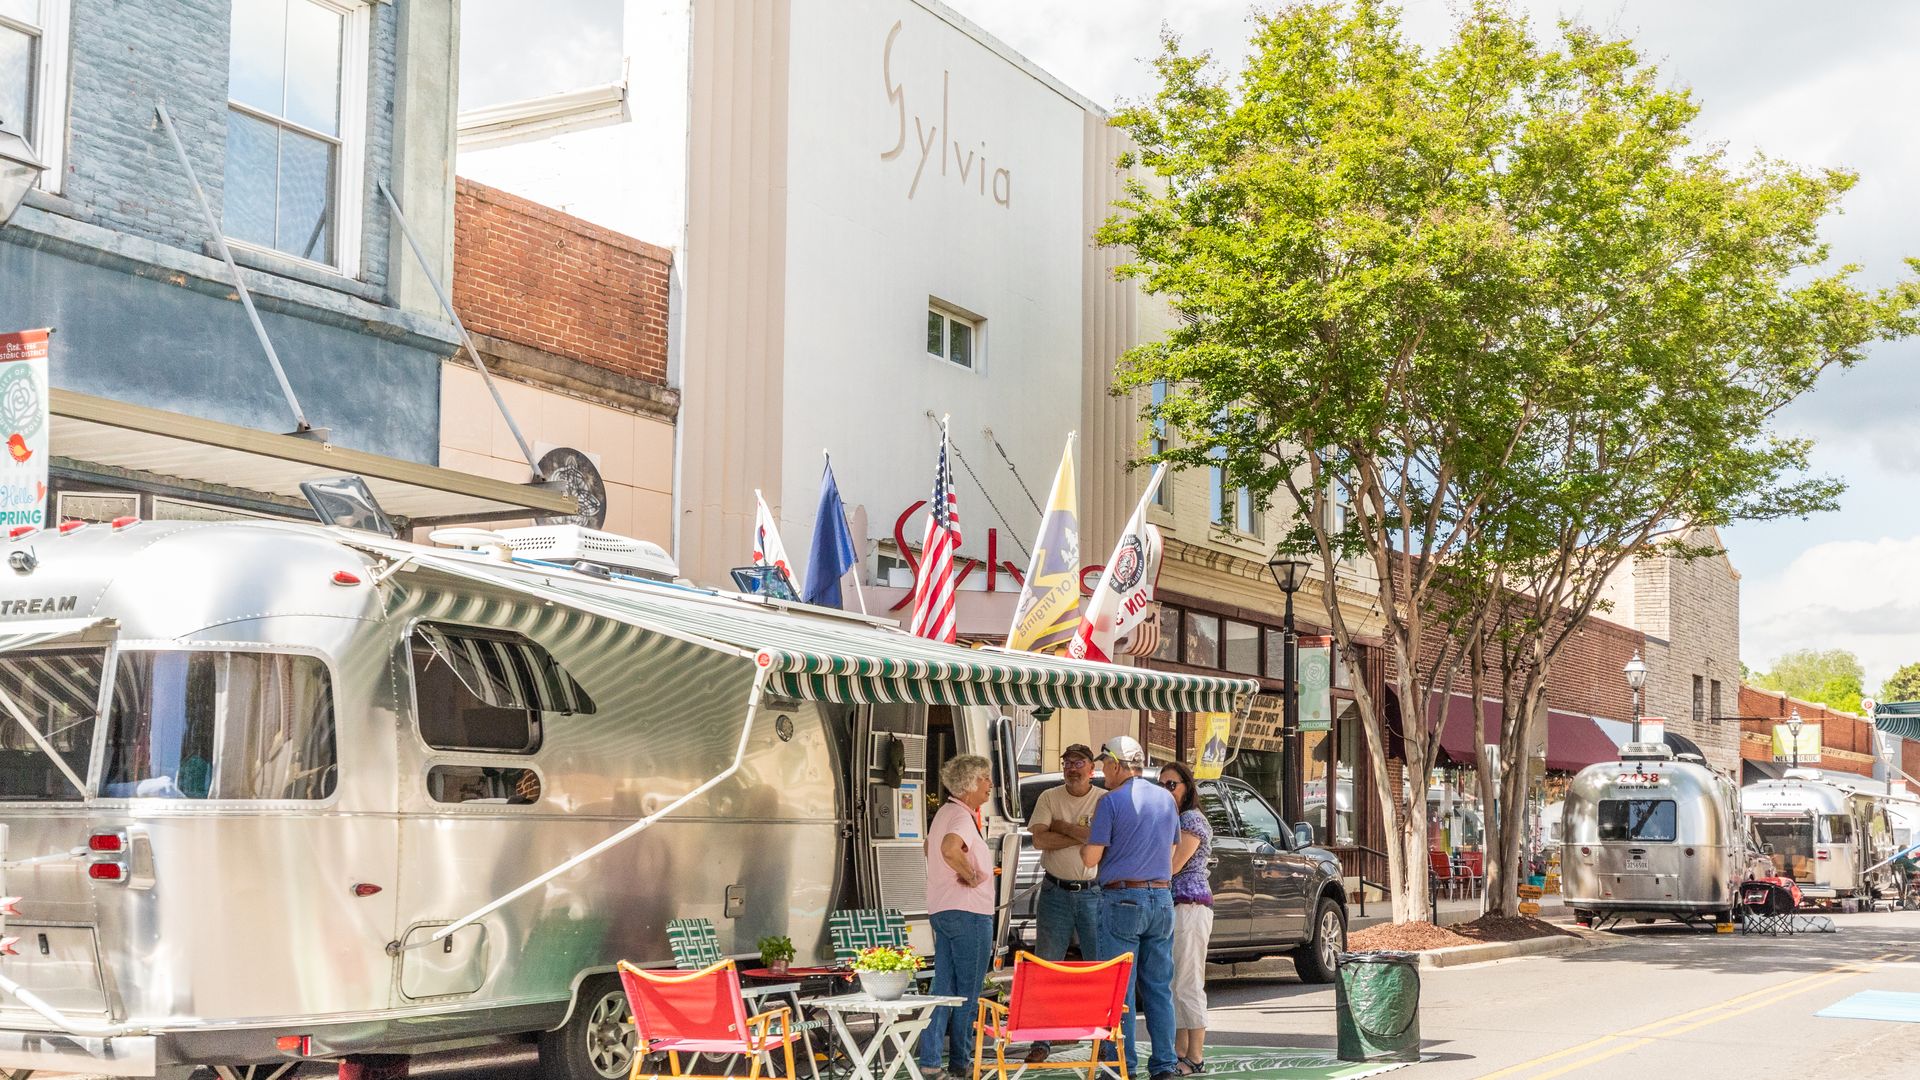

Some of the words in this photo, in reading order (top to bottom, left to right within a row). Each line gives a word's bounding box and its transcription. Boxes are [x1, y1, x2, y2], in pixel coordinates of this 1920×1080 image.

[880, 19, 1011, 210] Sylvia
[0, 509, 42, 525] PRING
[1, 596, 78, 615] TREAM
[1619, 773, 1660, 783] 2458
